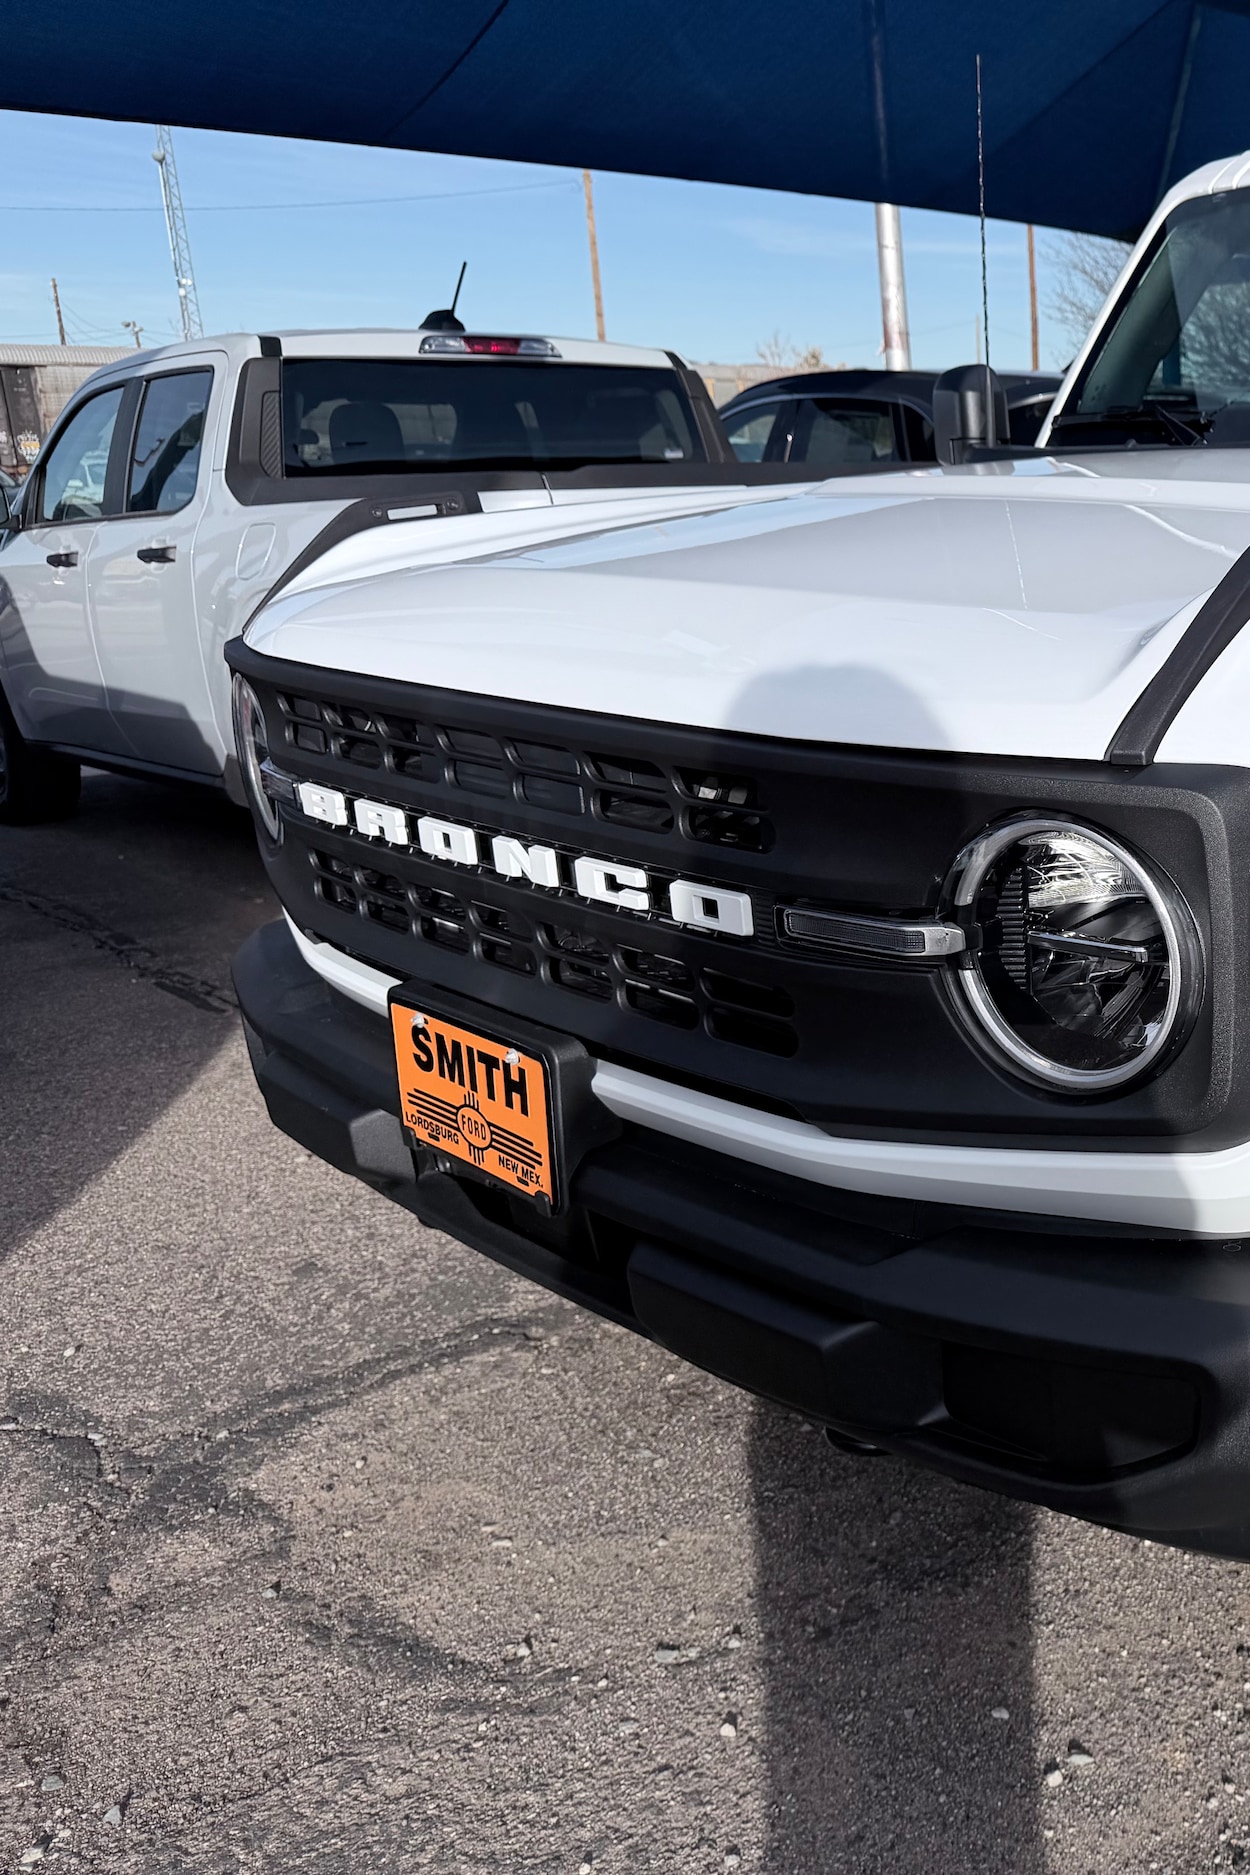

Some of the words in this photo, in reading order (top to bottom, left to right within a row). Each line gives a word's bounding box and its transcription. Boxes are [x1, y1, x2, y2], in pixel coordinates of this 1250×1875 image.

[299, 780, 754, 937] BRONCO
[411, 1023, 530, 1117] SMITH
[405, 1111, 460, 1145] LORDSBURG
[461, 1114, 487, 1141] FORD
[499, 1155, 520, 1176] NEW
